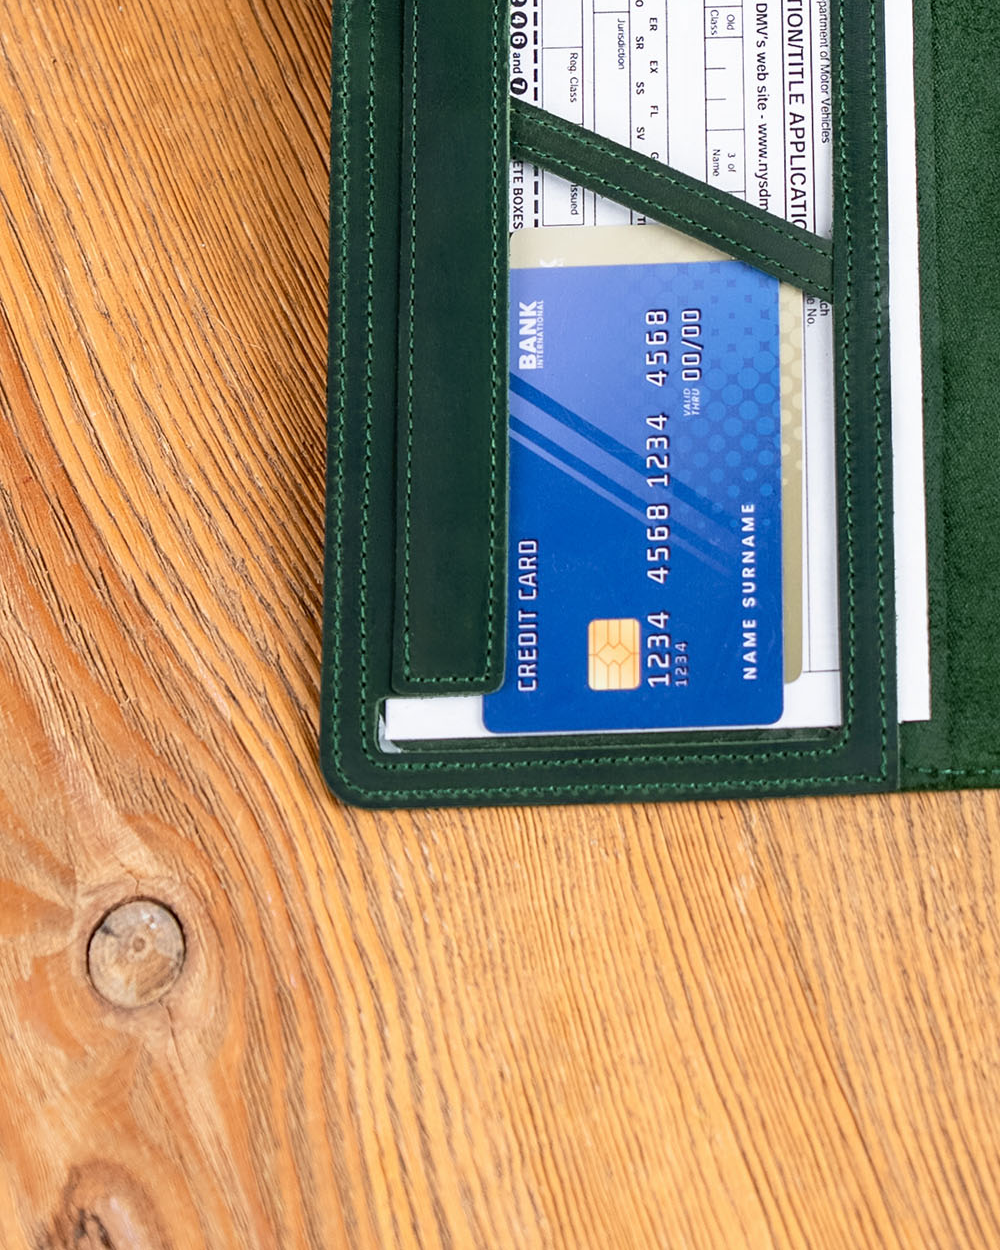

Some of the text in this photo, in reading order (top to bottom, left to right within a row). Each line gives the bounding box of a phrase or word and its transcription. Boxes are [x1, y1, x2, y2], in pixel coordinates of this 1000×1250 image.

[649, 17, 658, 31] ER
[710, 9, 720, 36] Class
[726, 14, 736, 31] Old
[617, 18, 626, 70] Jurisdiction
[635, 36, 644, 50] SR
[819, 50, 831, 62] of
[512, 52, 523, 74] and
[650, 60, 658, 74] EX
[756, 52, 770, 81] web
[569, 77, 579, 103] Class
[636, 81, 644, 95] SS
[820, 64, 831, 95] Motor
[650, 105, 658, 117] FL
[757, 86, 771, 111] site
[636, 127, 645, 141] SV
[821, 98, 831, 144] Vehicles
[711, 149, 721, 177] Name
[513, 188, 523, 229] BOXES
[518, 300, 538, 370] BANK
[536, 299, 544, 369] INTERNATIONAL
[682, 308, 703, 382] 00/00
[683, 388, 692, 417] VALID
[692, 388, 701, 416] THRU
[646, 308, 671, 688] 1234 4568 1234 4568
[741, 504, 757, 680] NAME SURNAME
[517, 539, 539, 692] CREDIT CARD
[675, 641, 688, 687] 1234
